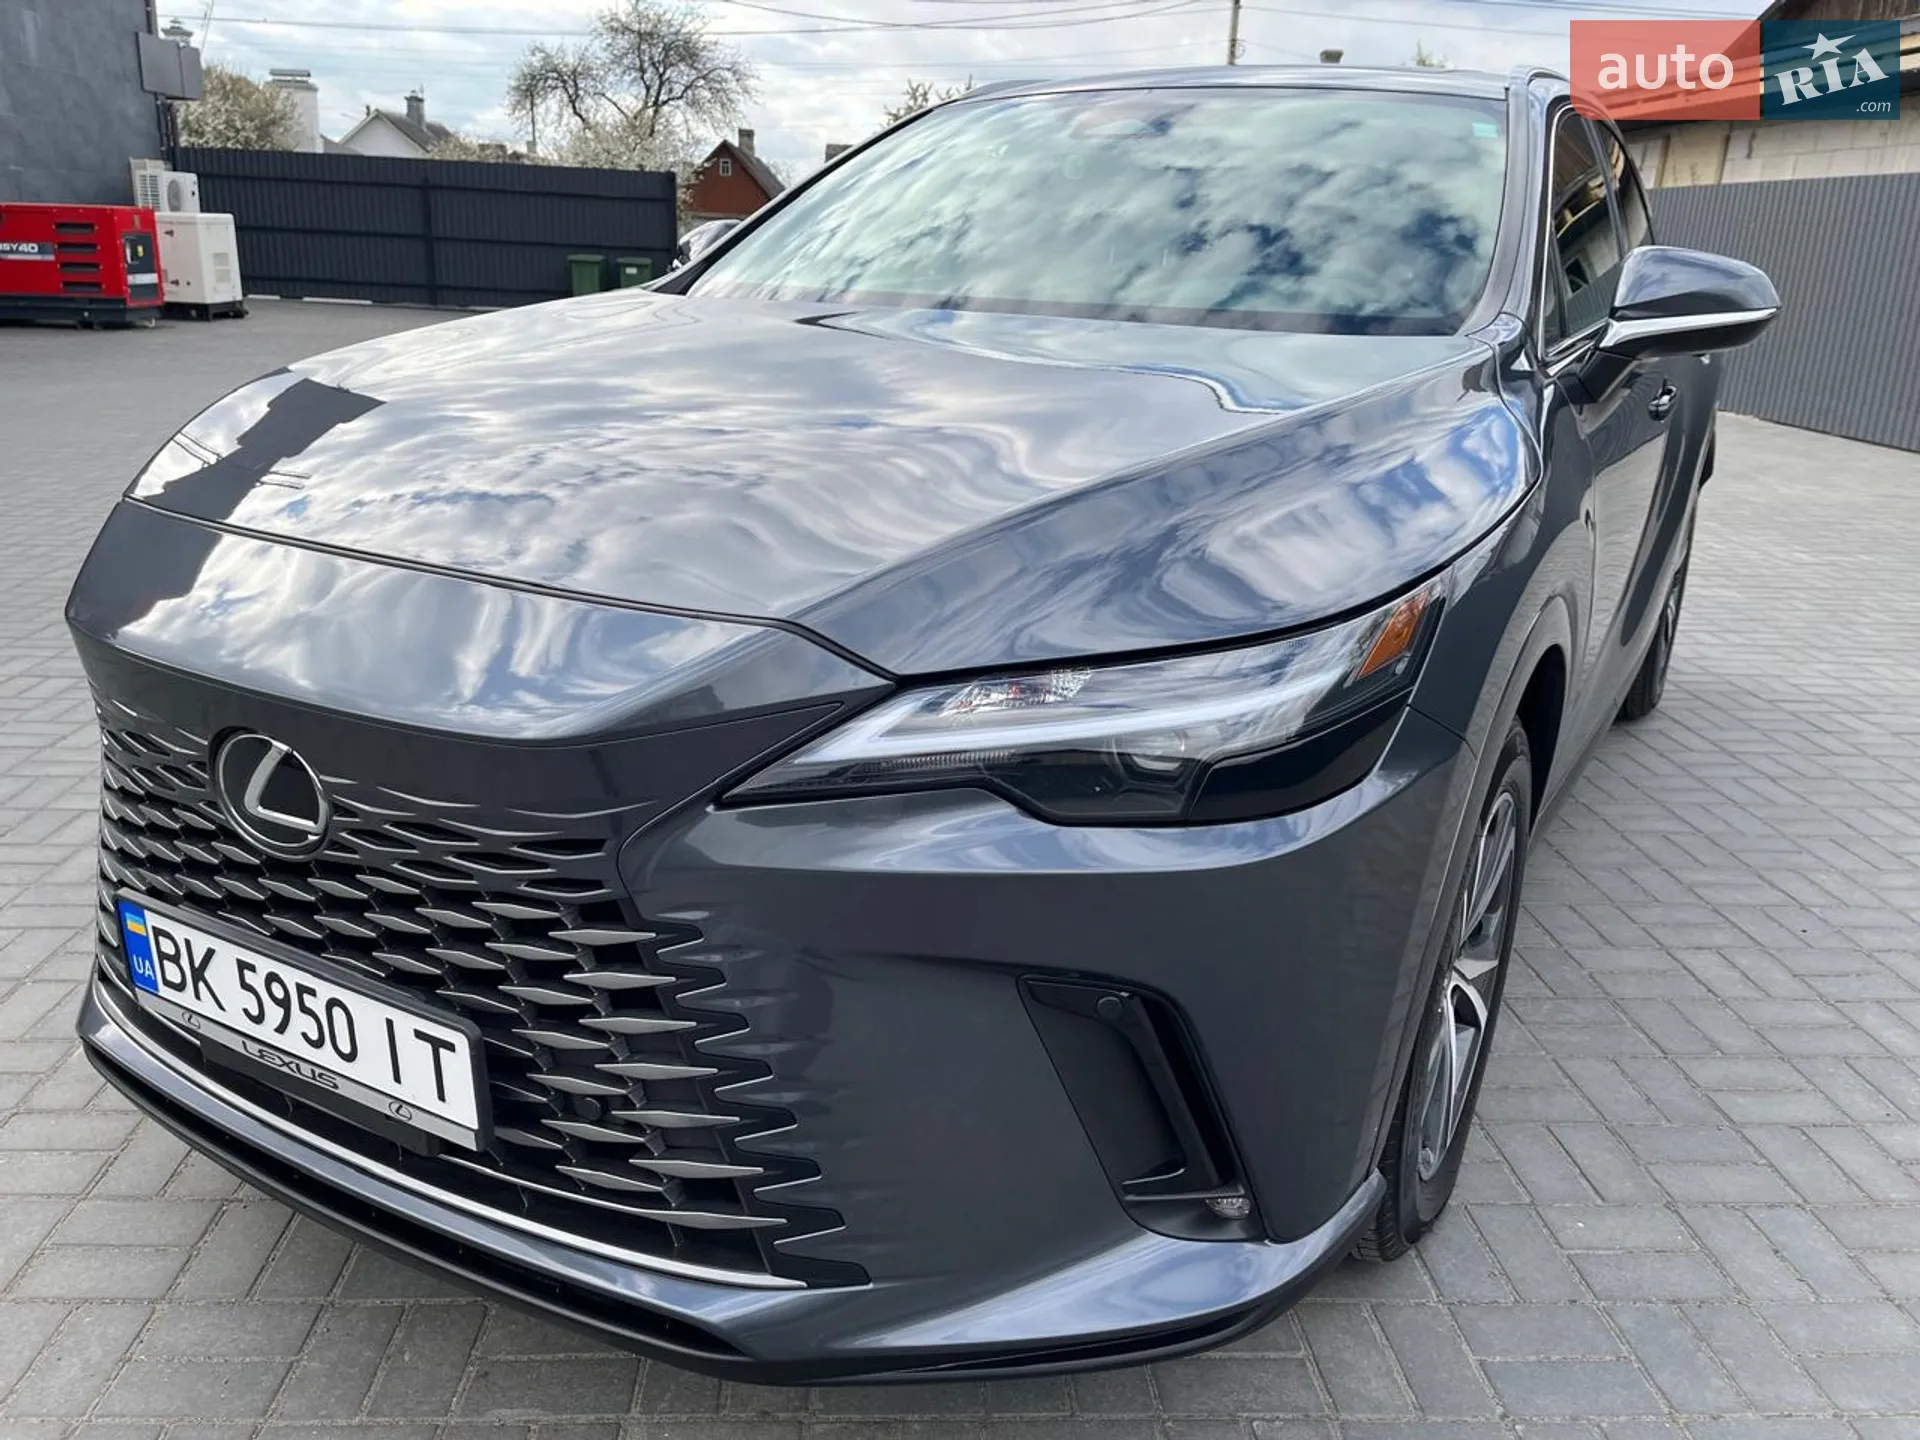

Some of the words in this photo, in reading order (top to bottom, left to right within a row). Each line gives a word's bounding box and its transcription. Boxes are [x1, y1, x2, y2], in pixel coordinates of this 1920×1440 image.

[132, 954, 155, 980] UA
[151, 925, 226, 1013] BK
[237, 958, 358, 1063] 5950
[386, 1017, 456, 1103] IT
[242, 1040, 339, 1090] LEXUS
